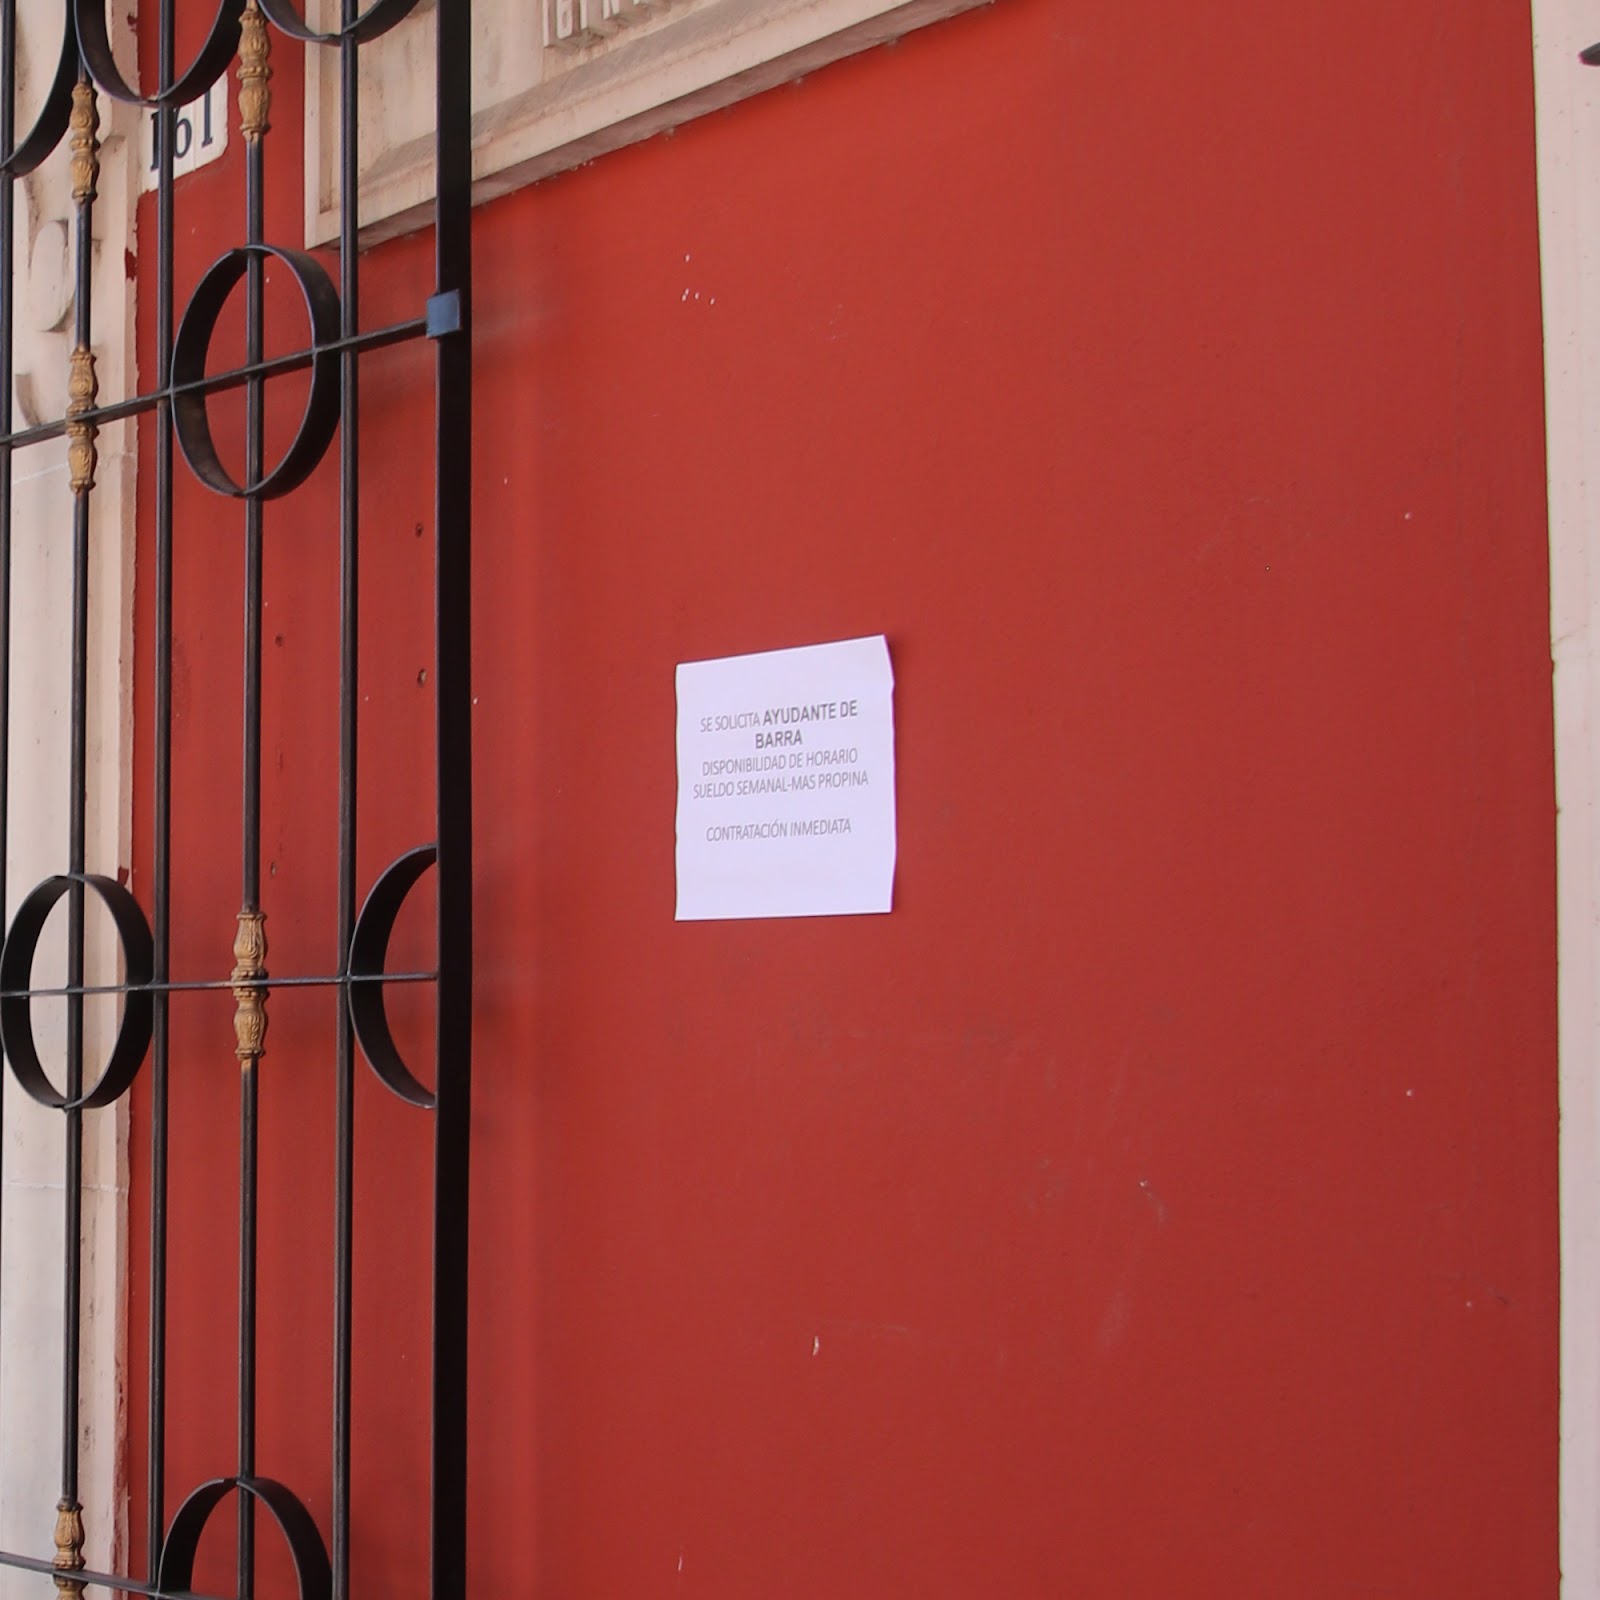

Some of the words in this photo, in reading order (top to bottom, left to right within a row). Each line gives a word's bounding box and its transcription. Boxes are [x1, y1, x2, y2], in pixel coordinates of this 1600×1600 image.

[700, 716, 714, 733] SE
[715, 712, 761, 732] SOLICITA
[762, 702, 837, 727] AYUDANTE
[840, 699, 858, 719] DE
[755, 729, 803, 750] BARRA
[702, 754, 787, 776] DISPONIBILIDAD
[789, 752, 803, 769] DE
[806, 747, 858, 767] HORARIO
[693, 781, 735, 800] SUELDO
[736, 774, 816, 796] SEMANAL-MAS
[818, 770, 869, 790] PROPINA
[706, 819, 788, 842] CONTRATACIÓN
[790, 818, 851, 837] INMEDIATA
